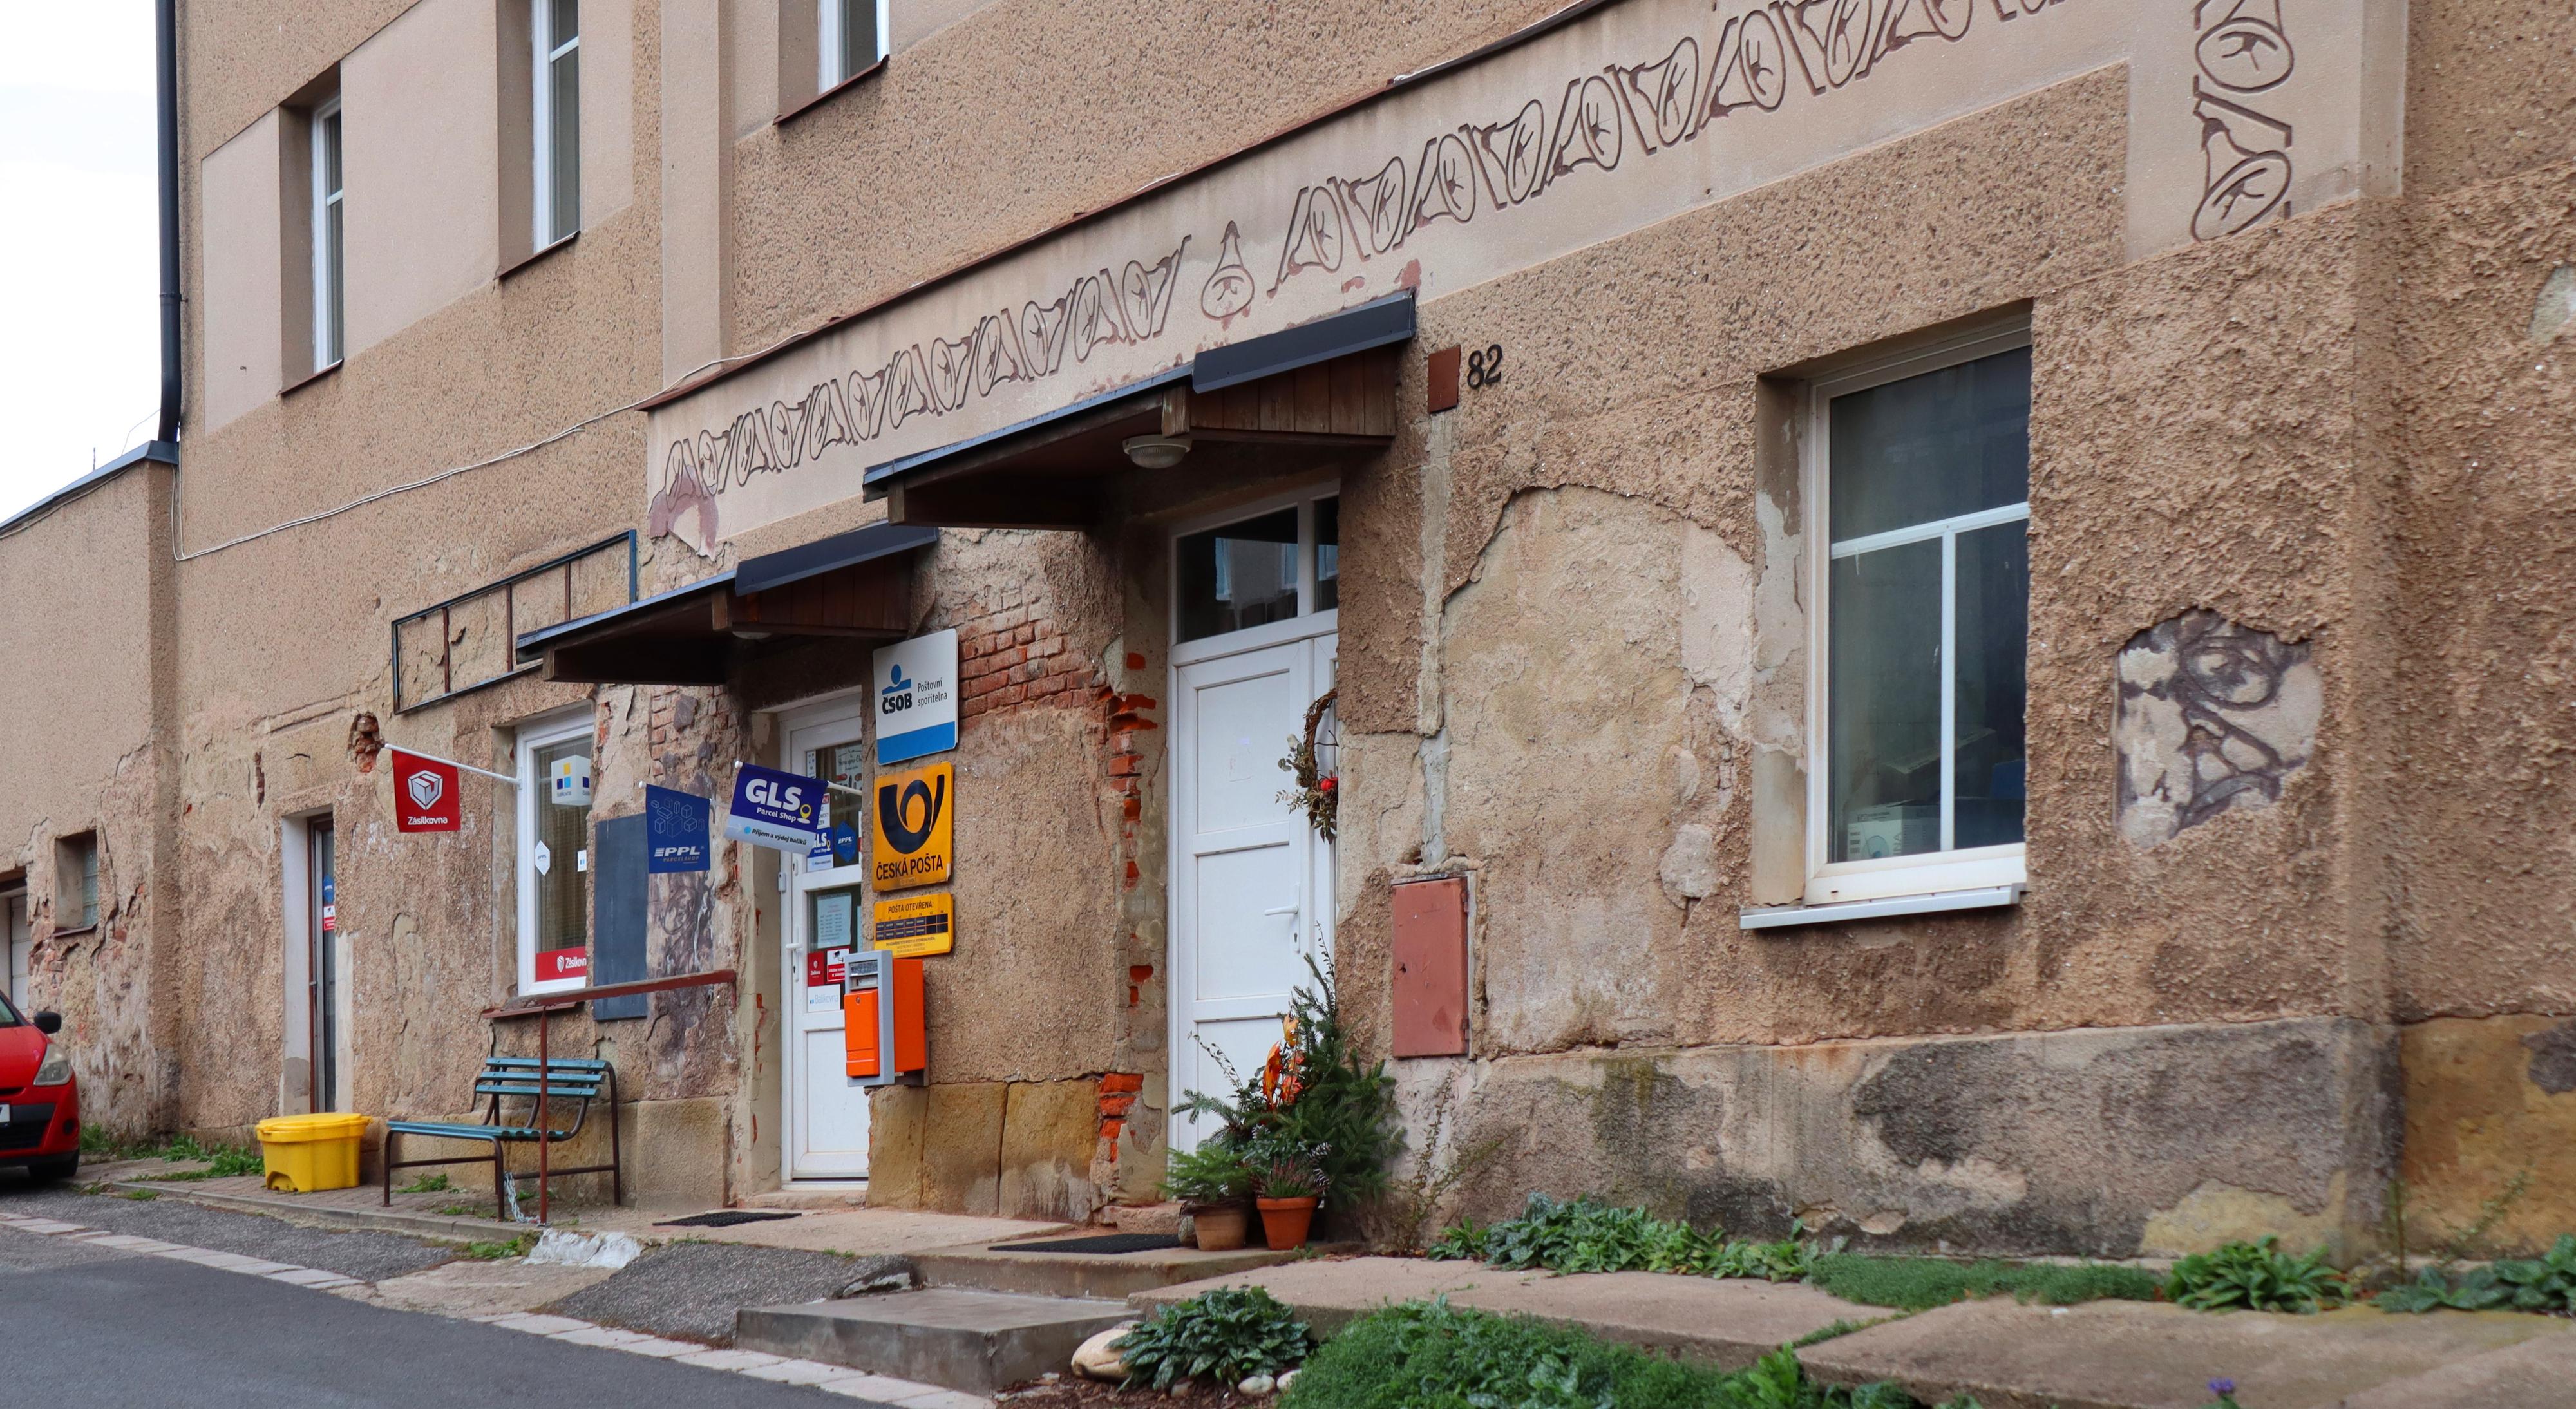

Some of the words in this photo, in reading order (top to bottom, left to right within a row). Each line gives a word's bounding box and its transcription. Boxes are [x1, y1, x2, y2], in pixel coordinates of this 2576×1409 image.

[1467, 344, 1502, 390] 82
[918, 677, 943, 692] Poštovní
[882, 692, 913, 714] ČSOB
[918, 692, 947, 708] spořitelna
[745, 779, 802, 811] GLS
[408, 816, 448, 825] Zásilkovna
[756, 807, 778, 818] Parcel
[779, 812, 797, 823] Shop
[752, 828, 770, 838] Příjem
[774, 833, 790, 843] výdej
[790, 836, 807, 846] balíků
[876, 858, 909, 880] ČESKÁ
[910, 853, 943, 875] POŠTA
[888, 904, 904, 914] POŠTA
[905, 900, 934, 911] OTEVŘENA:
[565, 956, 587, 969] Zásilkovn
